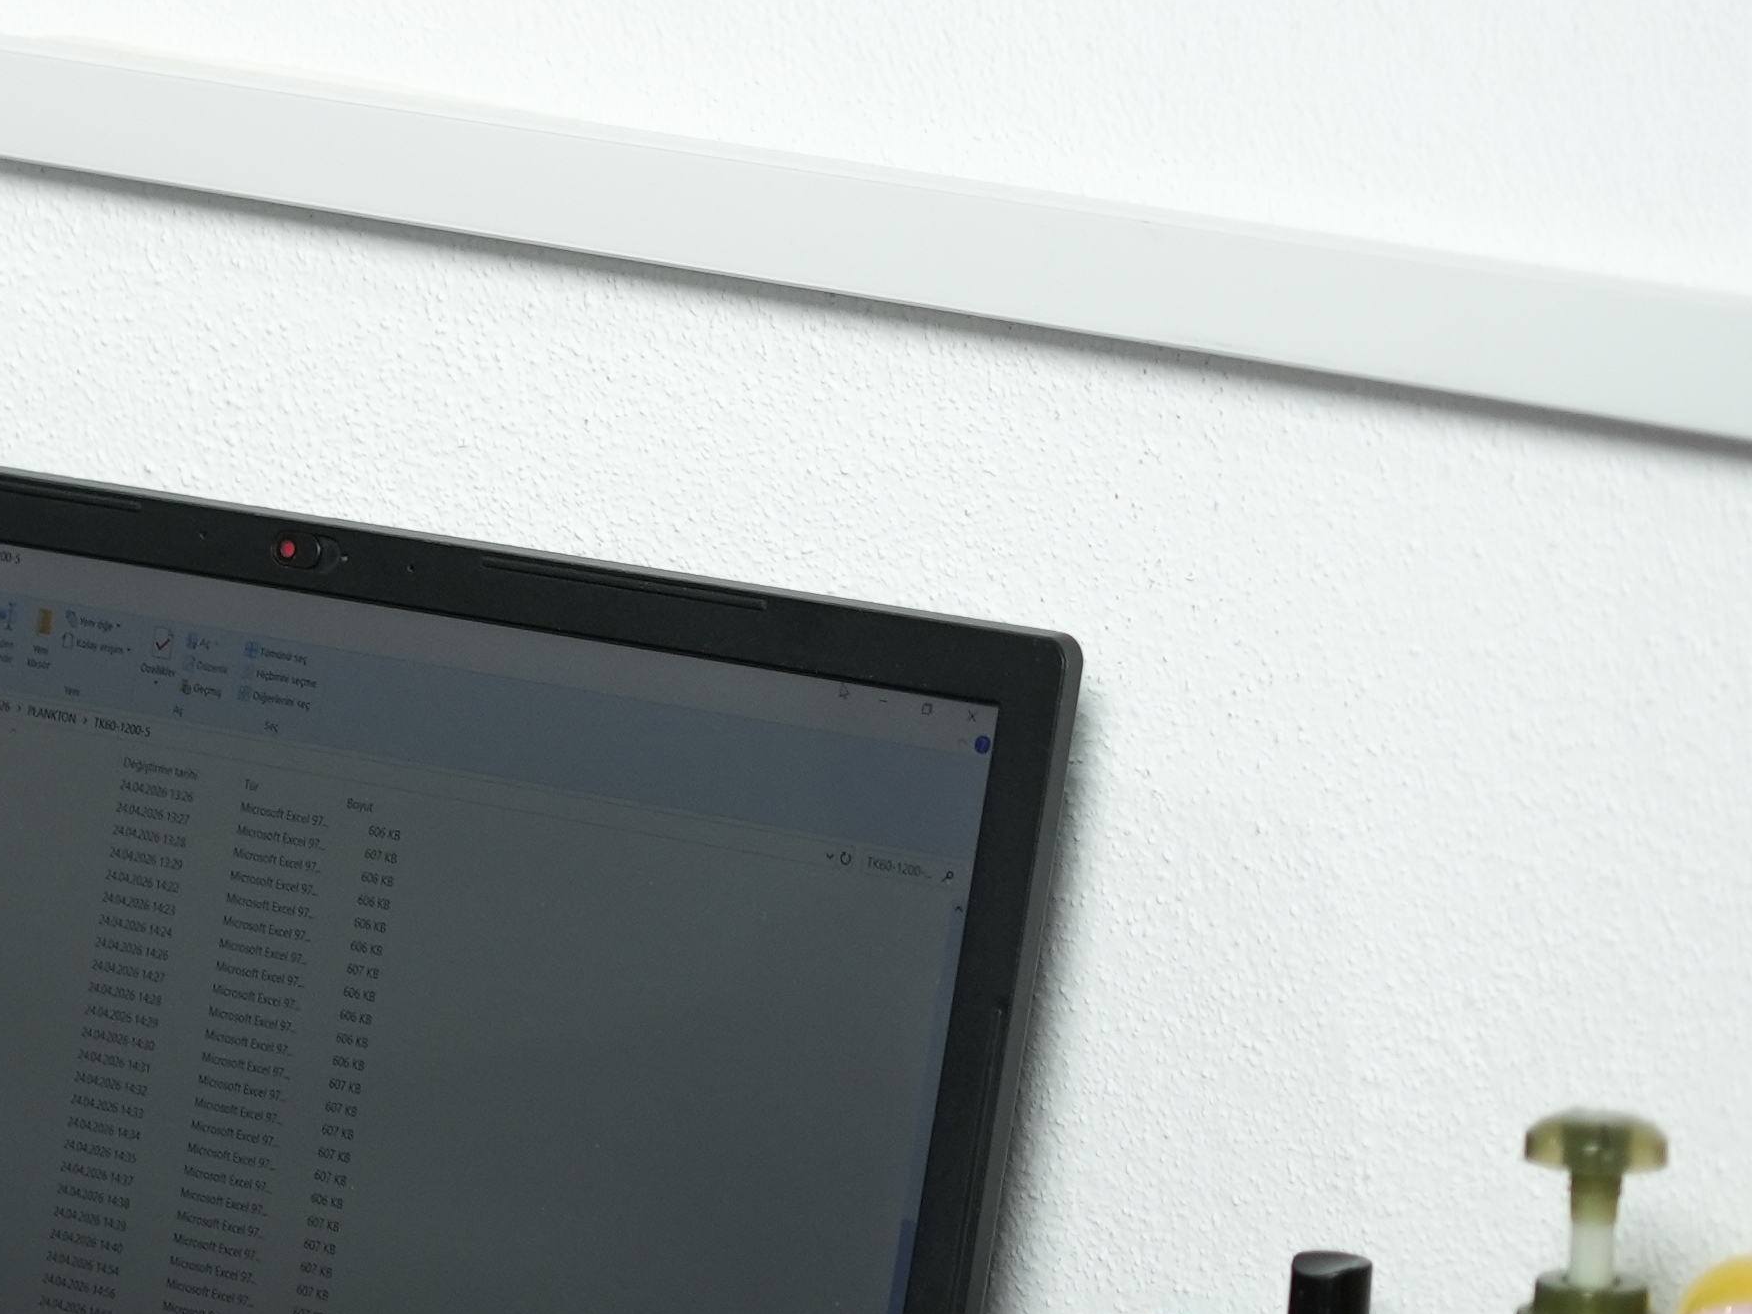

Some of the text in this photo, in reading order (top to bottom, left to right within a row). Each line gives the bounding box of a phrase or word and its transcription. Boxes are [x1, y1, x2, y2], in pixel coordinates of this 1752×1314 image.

[27, 705, 77, 724] PLANKTON
[94, 717, 151, 737] TK60-1200-5
[240, 801, 284, 821] Microsoft
[285, 810, 310, 826] Excel
[236, 824, 280, 844] Microsoft
[281, 833, 306, 849] Excel
[386, 828, 401, 841] KB
[382, 851, 398, 864] KB
